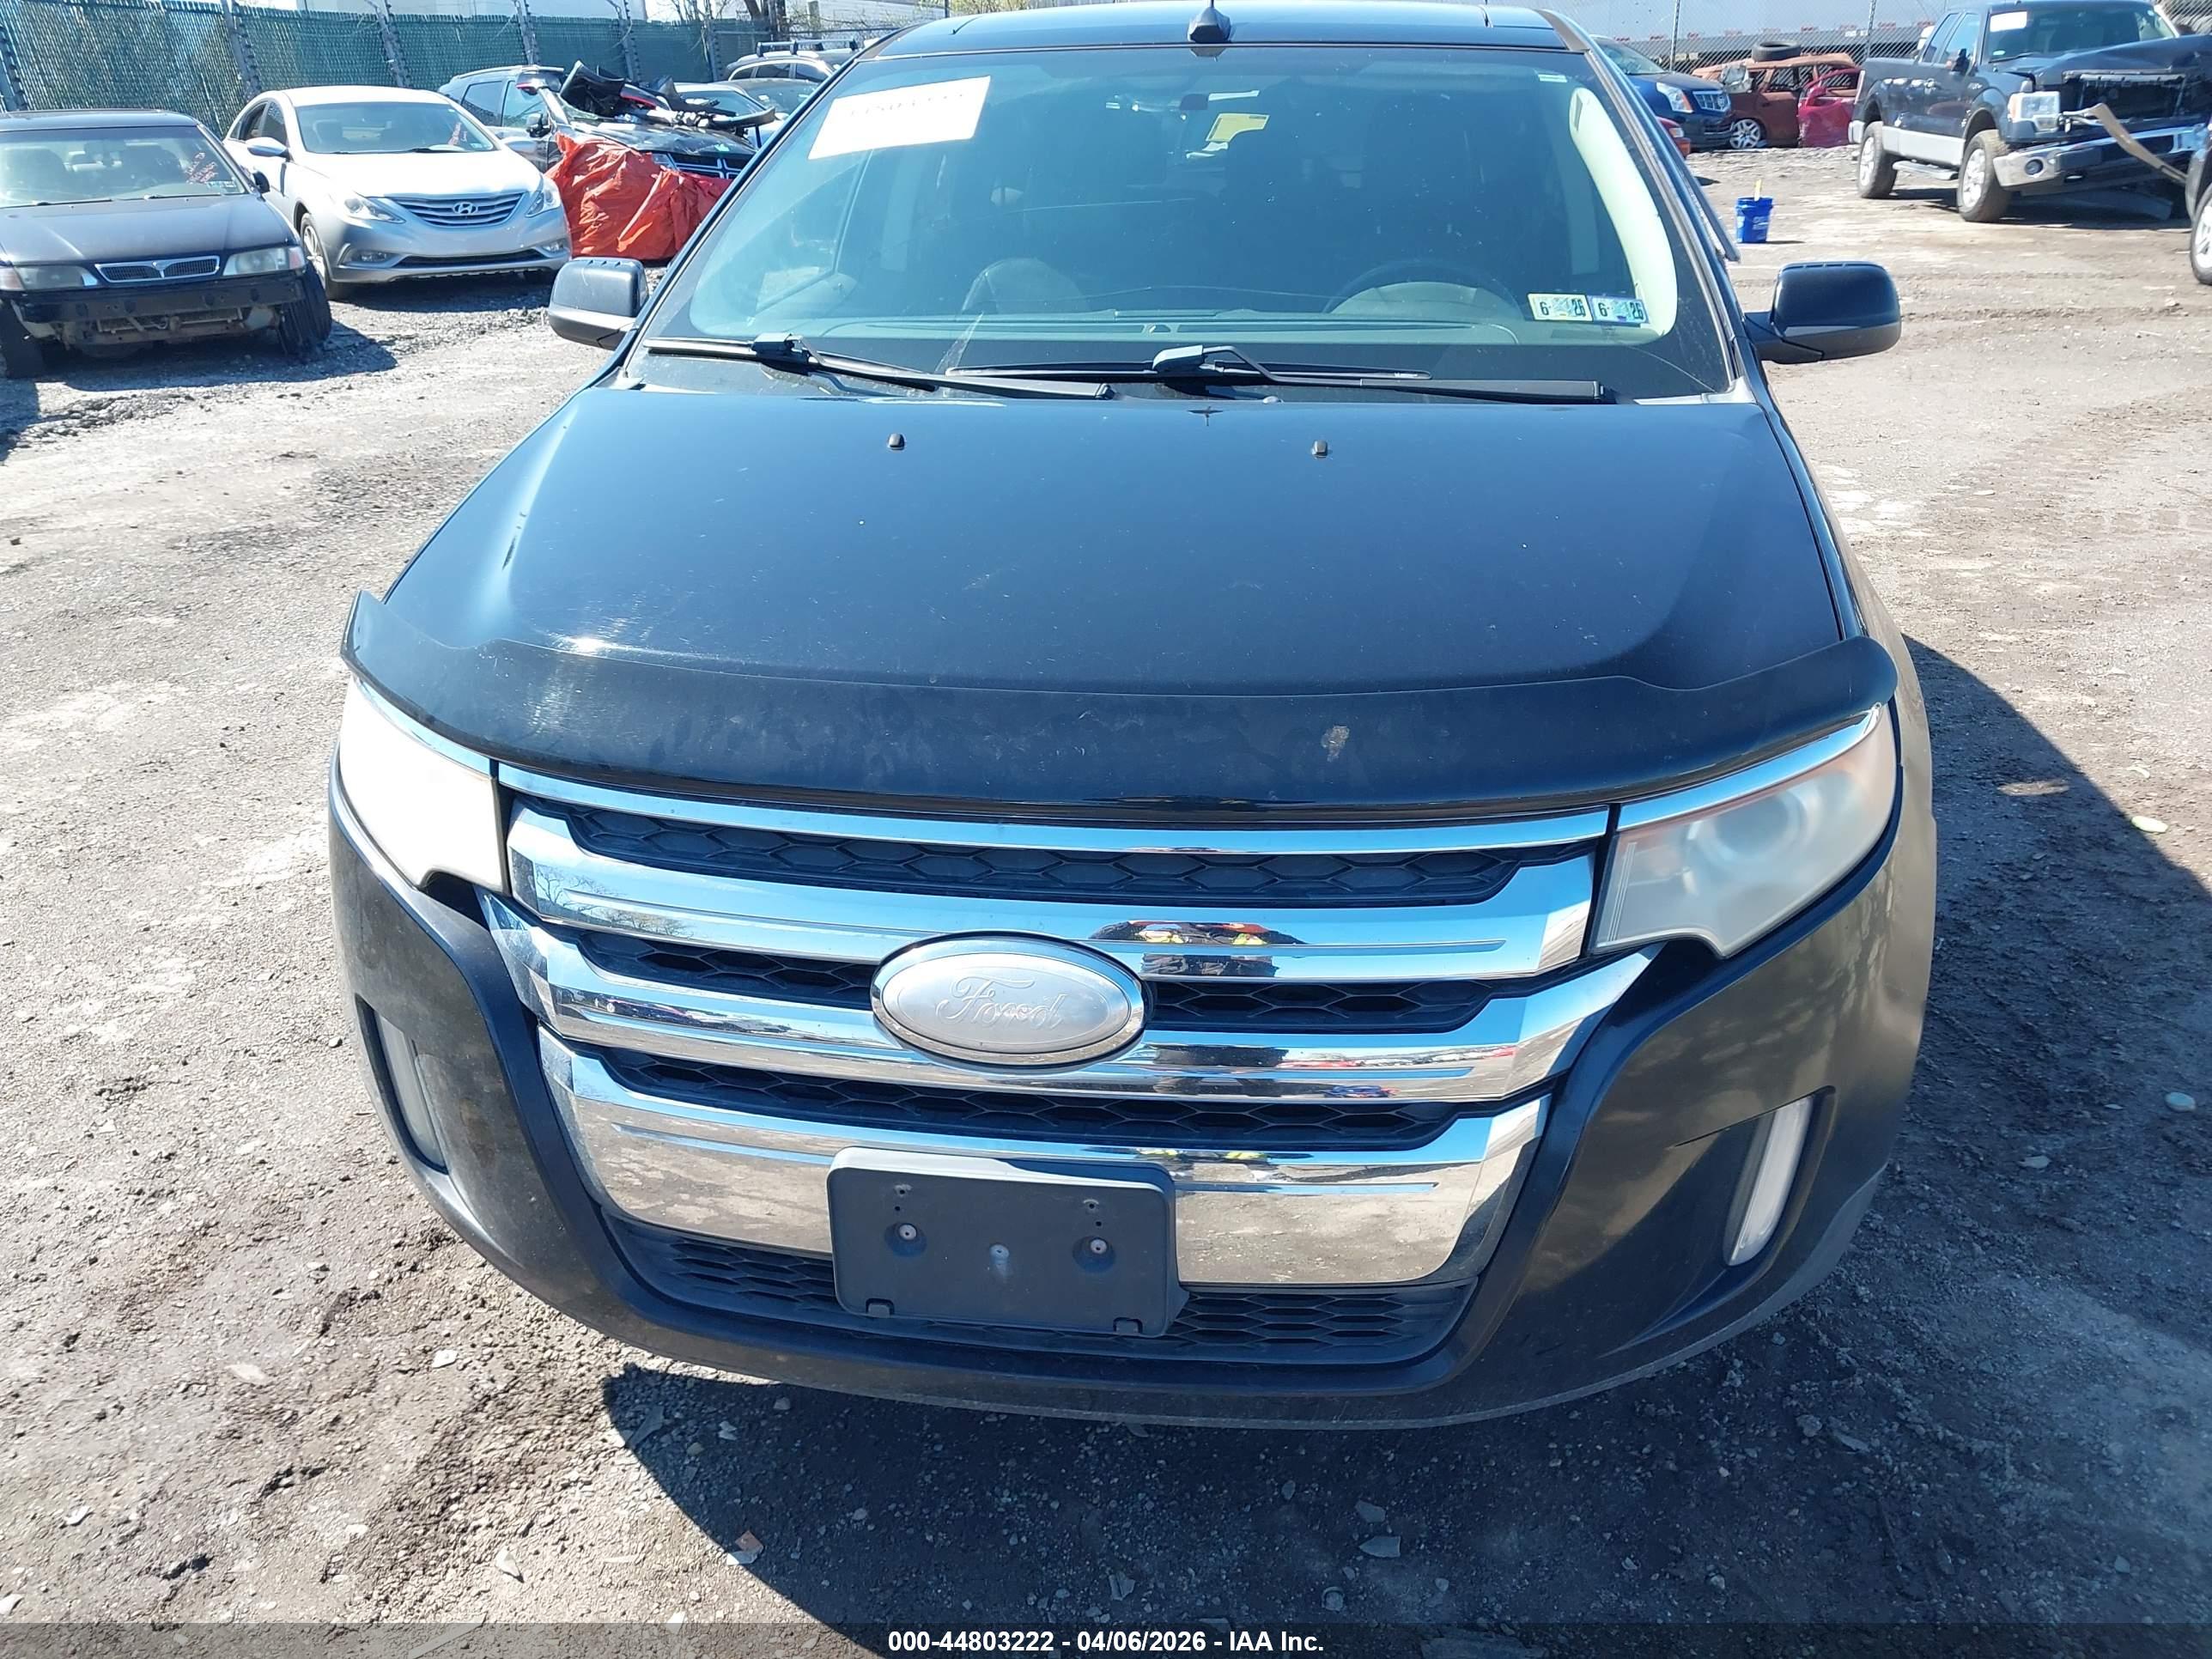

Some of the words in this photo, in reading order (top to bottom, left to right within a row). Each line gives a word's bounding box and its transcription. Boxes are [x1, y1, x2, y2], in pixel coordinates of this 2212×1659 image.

[1540, 301, 1549, 315] 6
[1598, 302, 1607, 317] 6
[935, 974, 1069, 1030] Ford
